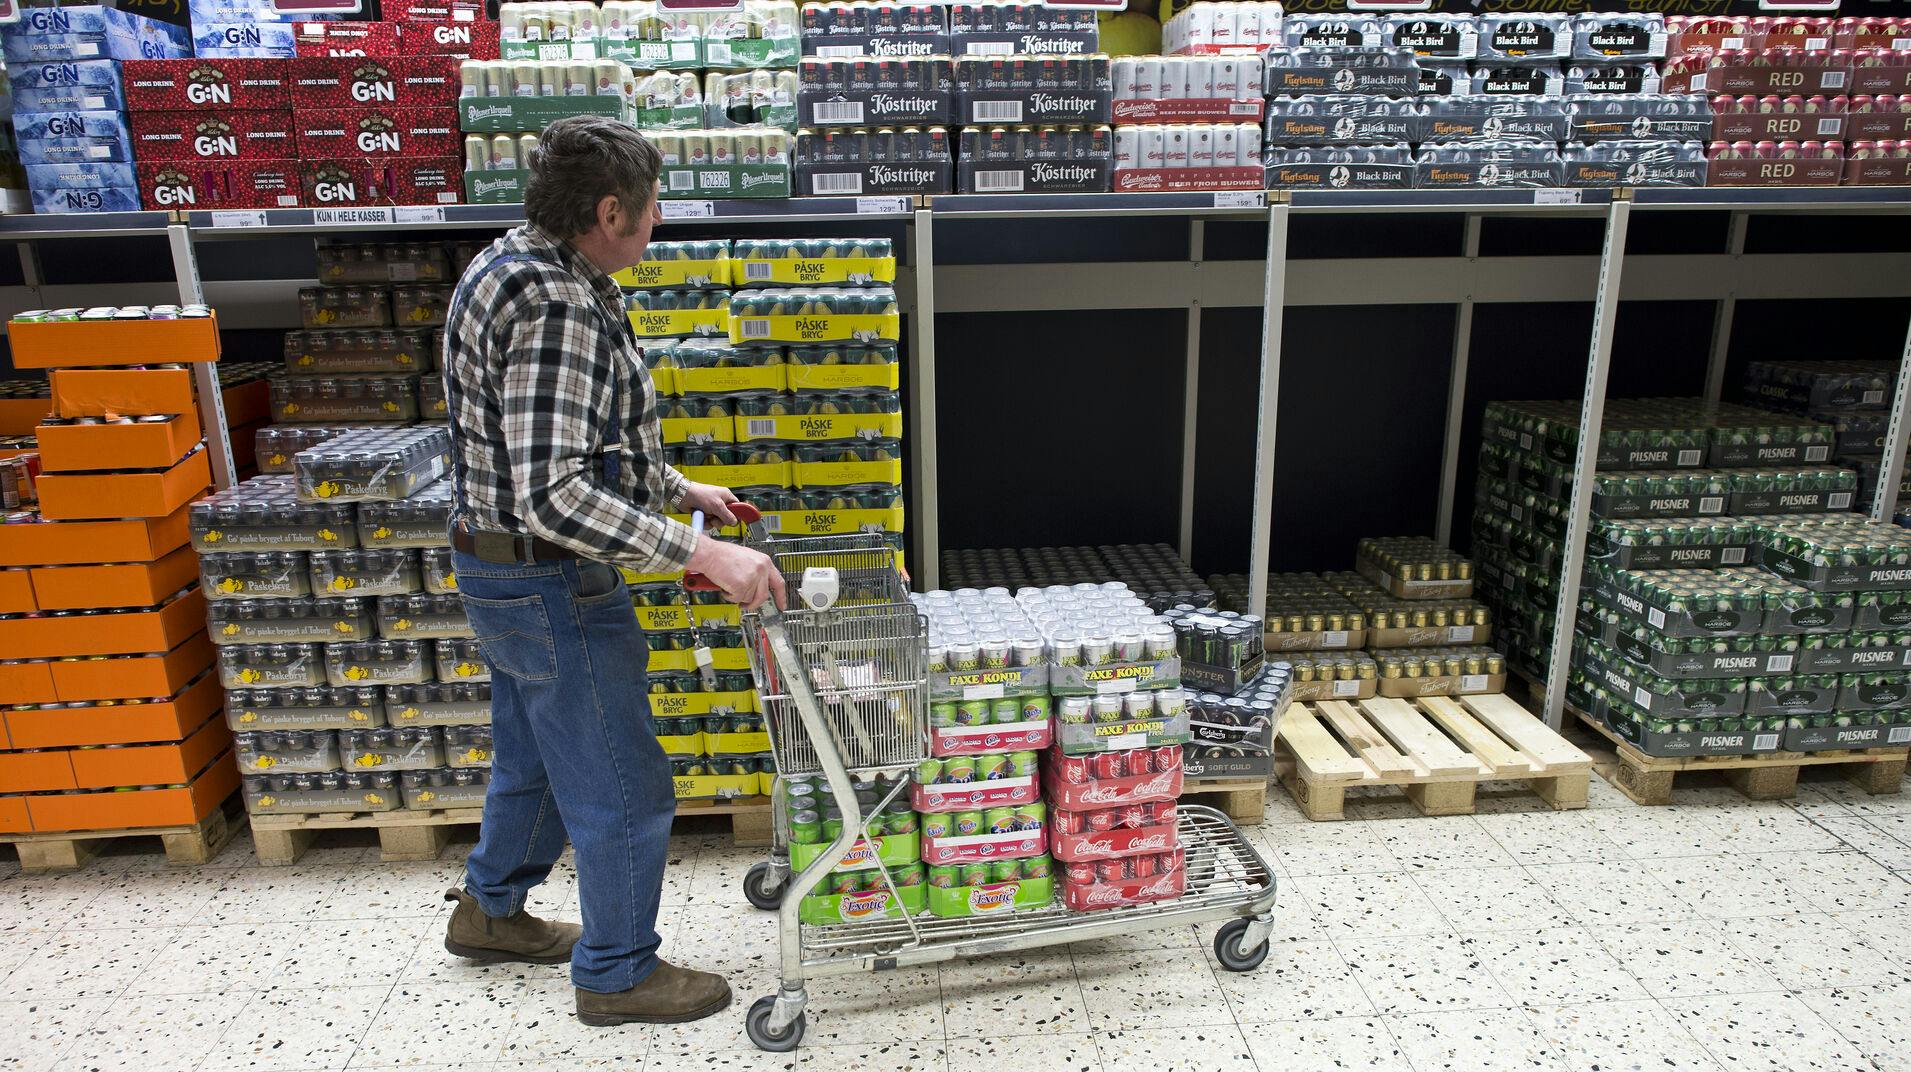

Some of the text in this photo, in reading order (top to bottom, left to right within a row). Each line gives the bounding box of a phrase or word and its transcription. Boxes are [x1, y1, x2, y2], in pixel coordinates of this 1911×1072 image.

[32, 12, 70, 30] G:N
[1021, 35, 1084, 55] Köstritzer
[1304, 38, 1346, 46] Black Bird
[1401, 37, 1443, 45] Black Bird
[1496, 36, 1538, 45] Black Bird
[1593, 36, 1634, 45] Black Bird
[642, 45, 668, 59] 762326
[870, 38, 933, 56] Köstritzer
[42, 65, 79, 82] G:N
[1361, 75, 1407, 84] Black Bird
[1769, 73, 1804, 86] RED
[1284, 74, 1324, 87] Fuglsang
[187, 83, 230, 104] G:N
[871, 94, 937, 115] Köstritzer
[1031, 93, 1096, 114] Köstritzer
[469, 105, 512, 122] Pilsner Urquell
[49, 117, 85, 135] G:N
[1285, 122, 1325, 135] Fuglsang
[1362, 123, 1406, 132] Black Bird
[1767, 120, 1801, 132] RED
[195, 137, 237, 156] G:N
[870, 165, 935, 185] Köstritzer
[1032, 163, 1096, 183] Köstritzer
[1280, 170, 1320, 182] Fuglsang
[1357, 171, 1401, 180] Black Bird
[1431, 169, 1471, 181] Fuglsang
[1578, 168, 1617, 180] Fuglsang
[1761, 164, 1795, 177] RED
[701, 172, 728, 187] 762326
[742, 172, 784, 188] Pilsner Urquell
[475, 179, 517, 195] Pilsner Urquell
[317, 211, 386, 222] KUN I HELE KASSER
[632, 264, 662, 276] PÅSKE
[794, 261, 825, 274] PÅSKE
[638, 275, 658, 284] BRYG
[800, 272, 820, 281] BRYG
[640, 312, 670, 326] PÅSKE
[796, 318, 828, 331] PÅSKE
[646, 323, 666, 333] BRYG
[802, 328, 823, 339] BRYG
[800, 417, 832, 429] PÅSKE
[806, 427, 828, 438] BRYG
[1629, 451, 1668, 463] PILSNER
[1758, 447, 1795, 459] PILSNER
[1650, 499, 1689, 510] PILSNER
[1780, 495, 1818, 506] PILSNER
[805, 512, 836, 524] PÅSKE
[811, 522, 832, 532] BRYG
[428, 531, 448, 540] brygg
[1671, 549, 1711, 561] PILSNER
[1870, 569, 1911, 581] PILSNER
[648, 608, 678, 620] PÅSKE
[654, 619, 674, 627] BRYG
[950, 672, 1022, 685] FAXE KONDI
[1084, 666, 1154, 680] FAXE KONDI
[1095, 722, 1164, 736] FAXE KONDI
[674, 779, 695, 788] ÅSKE
[676, 788, 690, 796] RYG
